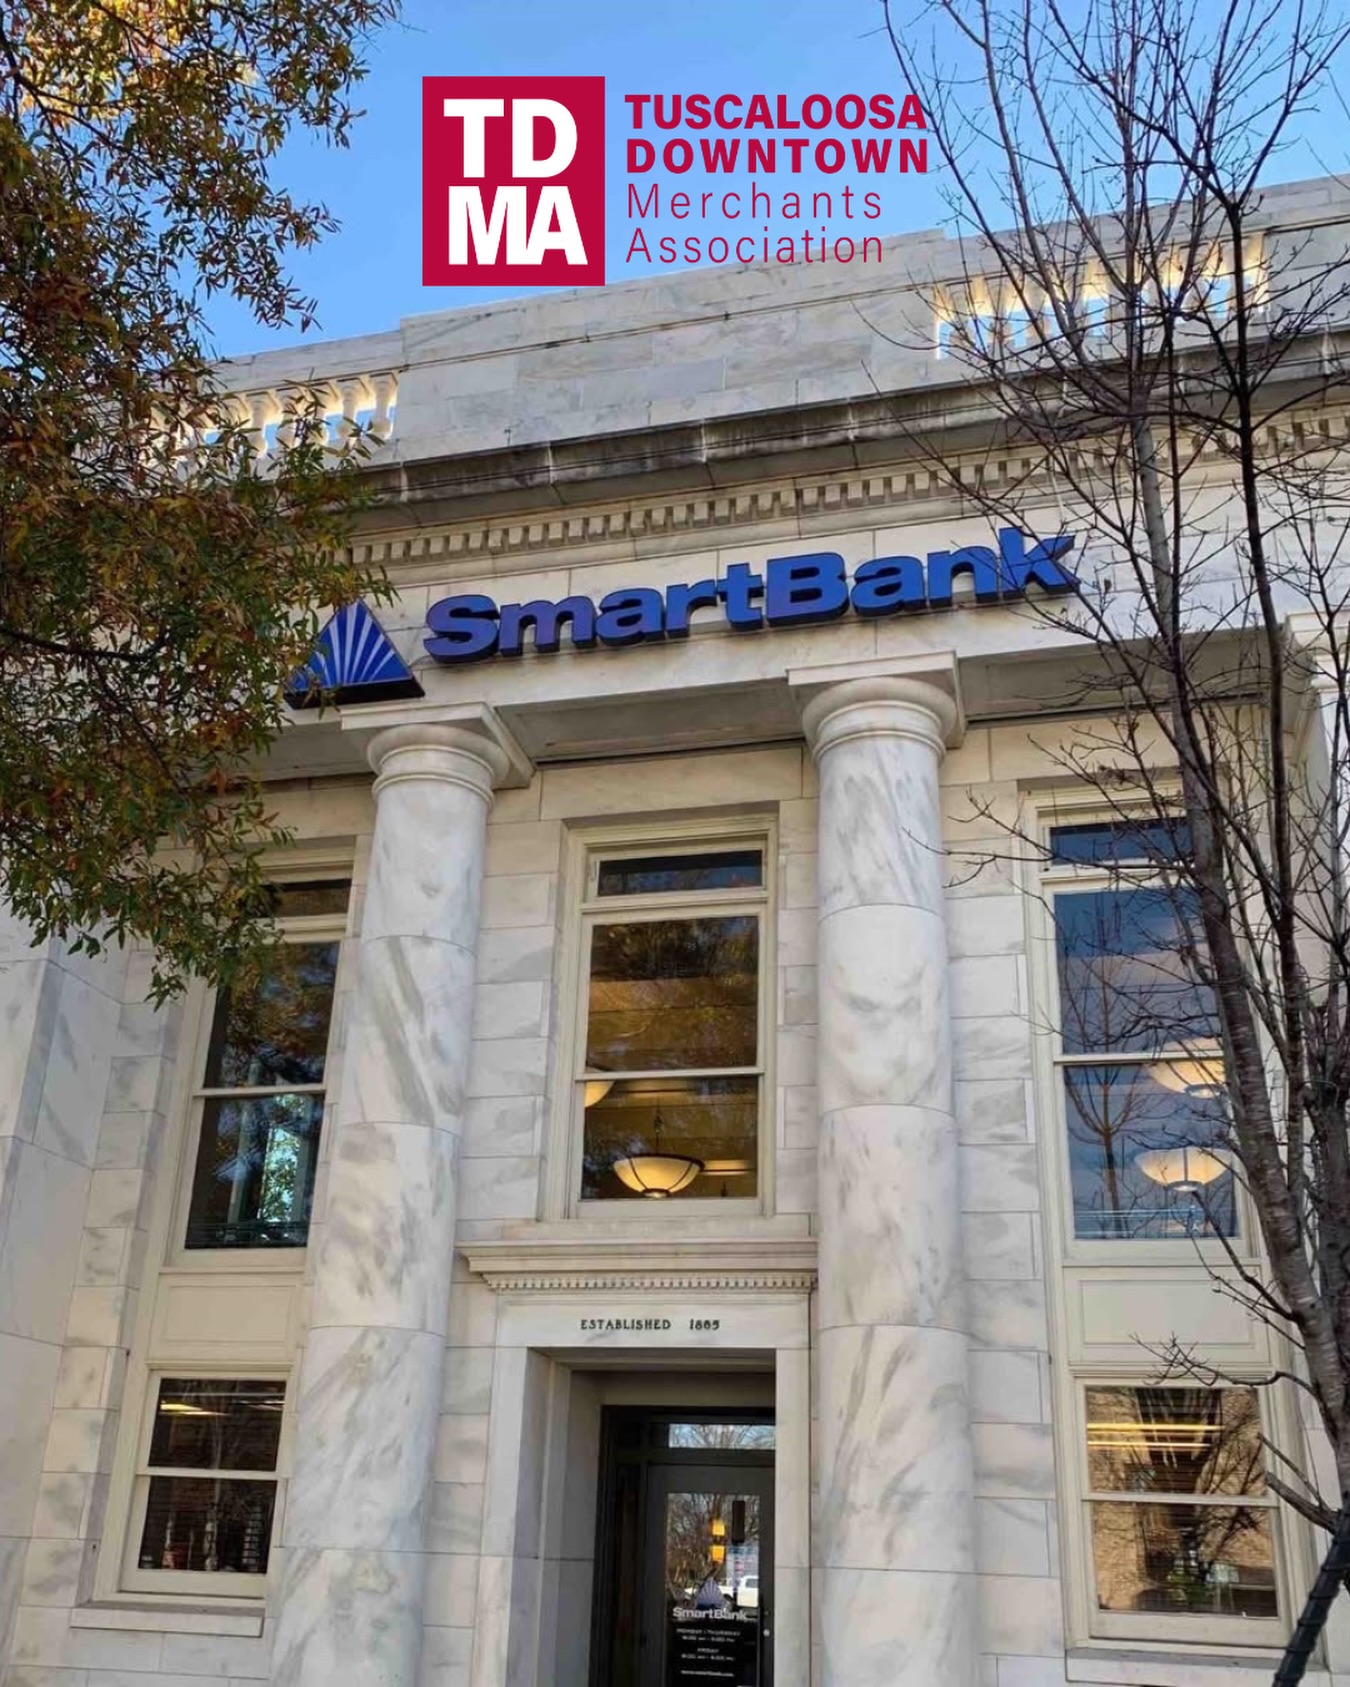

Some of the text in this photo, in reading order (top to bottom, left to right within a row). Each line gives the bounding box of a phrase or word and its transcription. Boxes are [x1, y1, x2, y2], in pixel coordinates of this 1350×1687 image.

[424, 525, 1081, 665] SmartBank
[580, 1319, 672, 1331] ESTABLISHED
[672, 1606, 747, 1621] SmartBank
